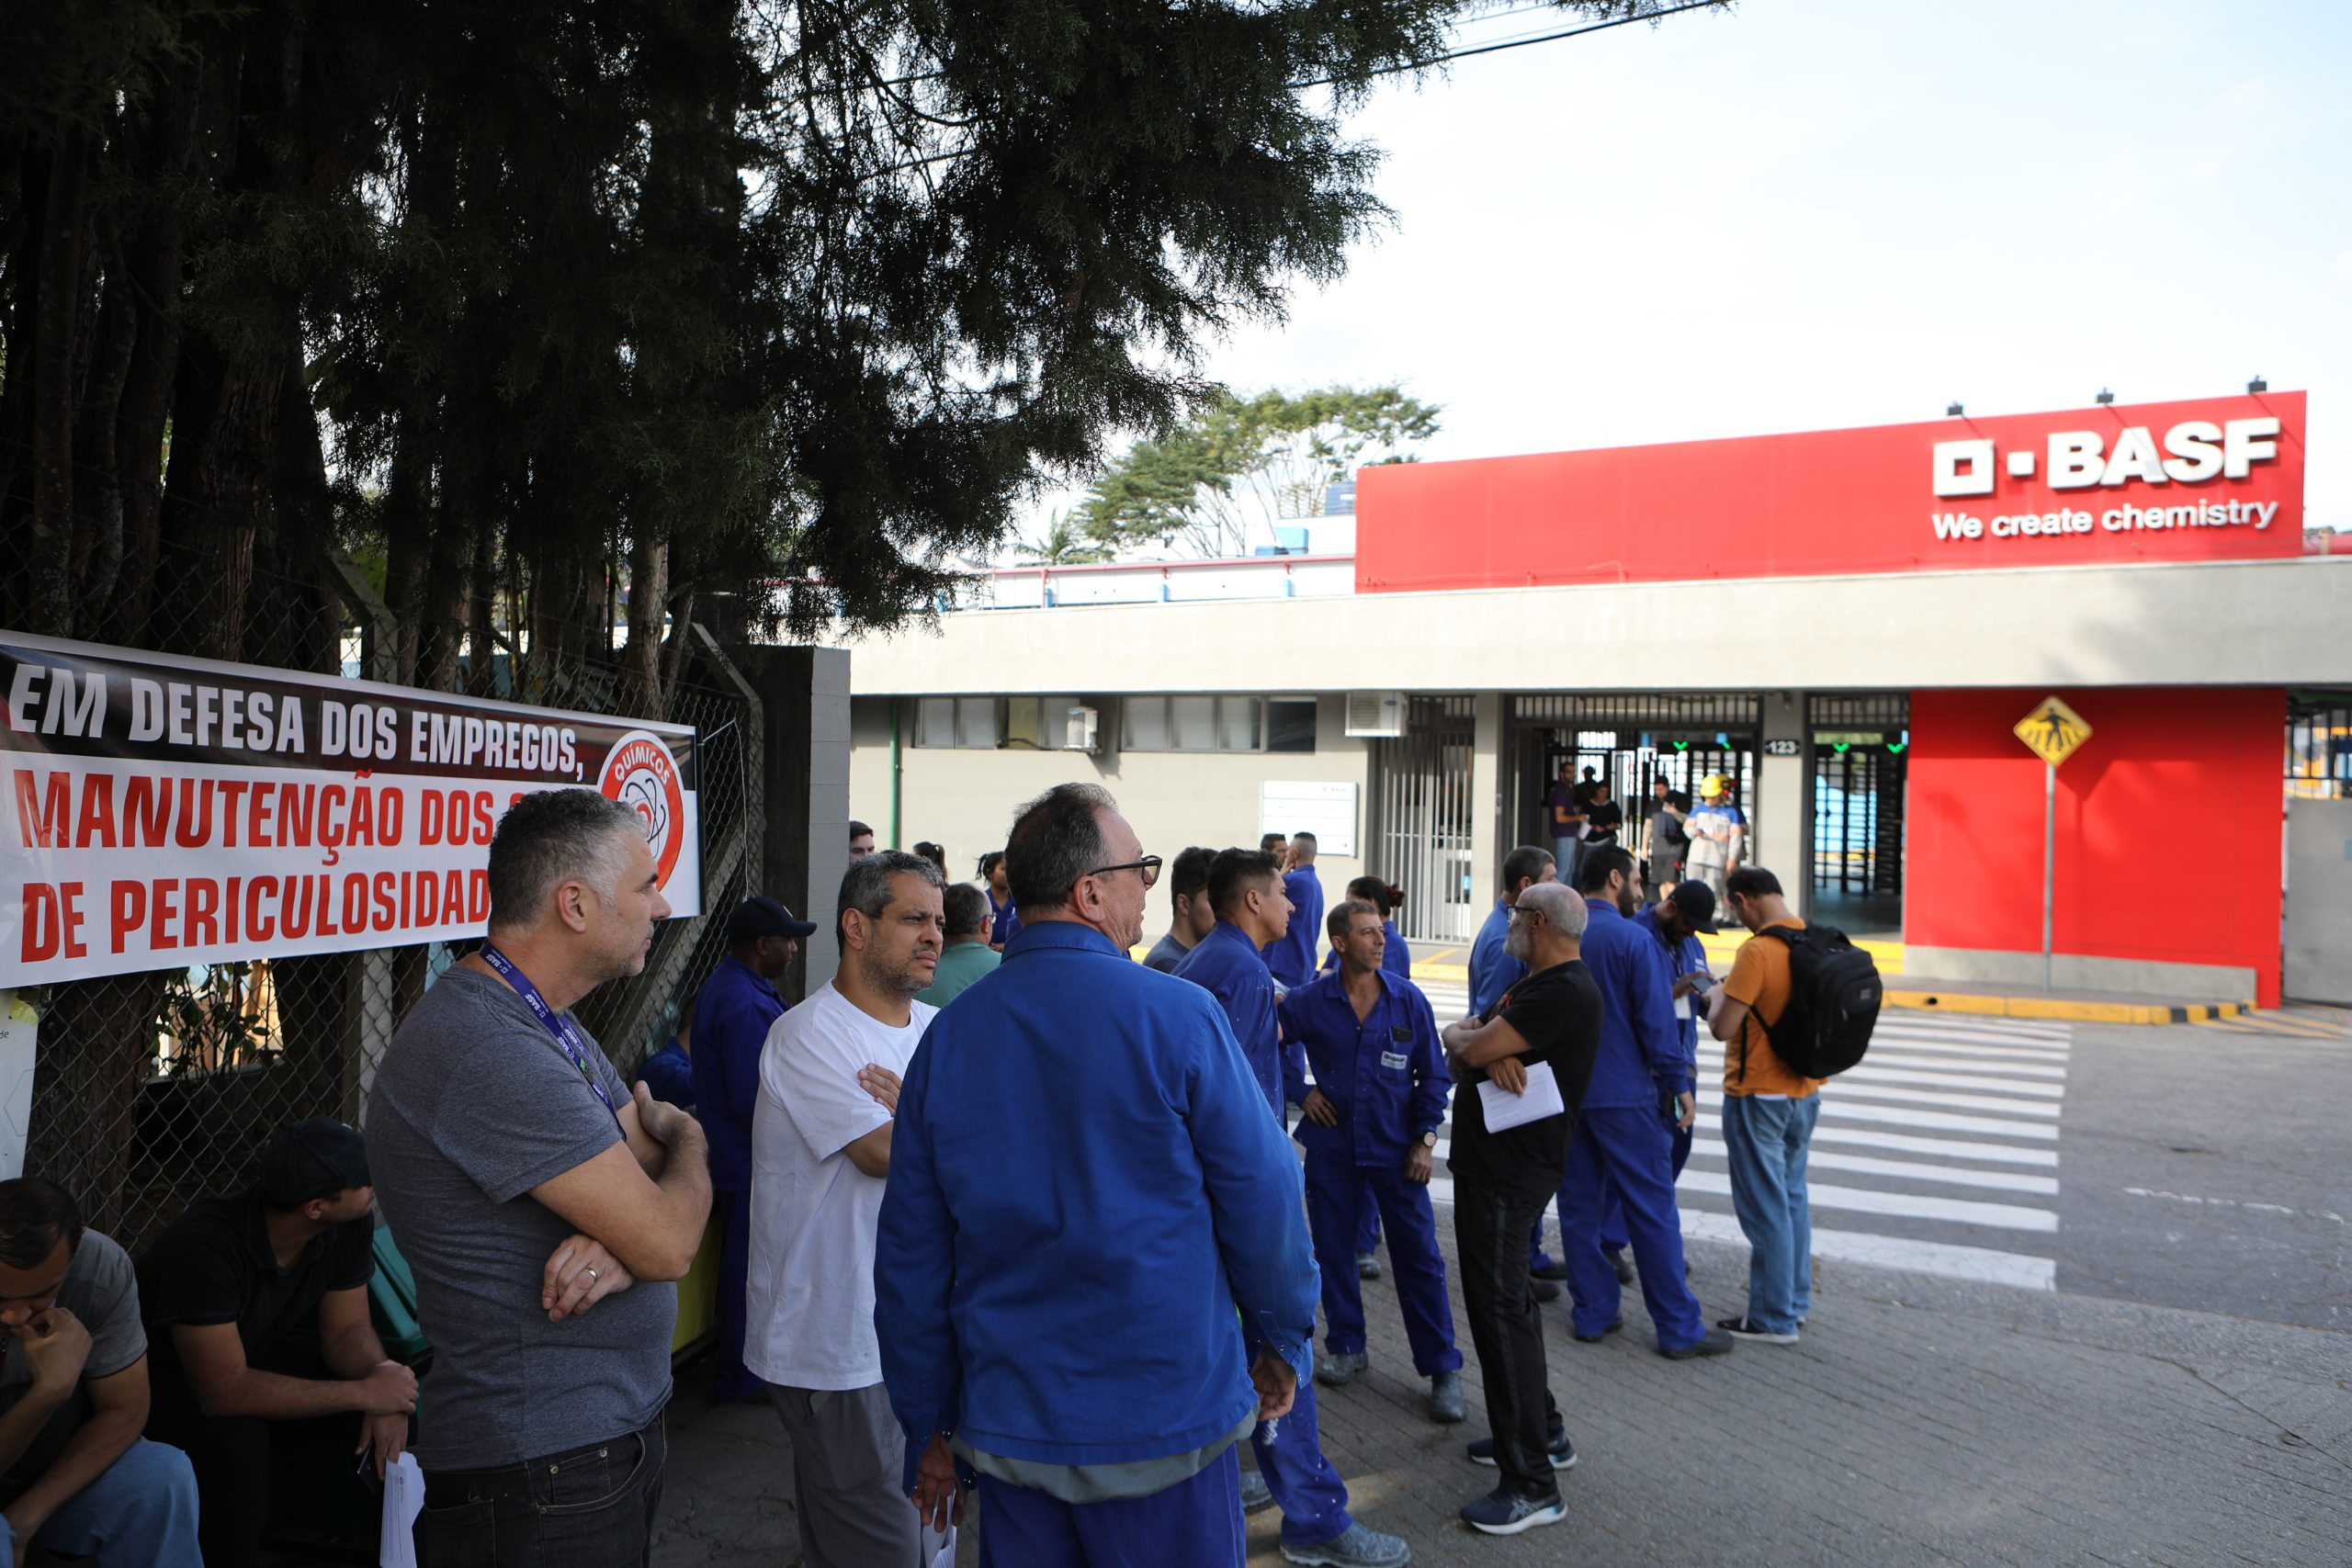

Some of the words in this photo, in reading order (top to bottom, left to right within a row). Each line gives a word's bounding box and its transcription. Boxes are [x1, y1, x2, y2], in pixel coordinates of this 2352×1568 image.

[2047, 417, 2280, 490] BASF
[1932, 513, 1983, 539] We
[1991, 507, 2093, 537] create
[2101, 498, 2278, 531] chemistry
[9, 663, 107, 739] EM
[129, 677, 305, 754] DEFESA
[322, 700, 397, 761] DOS
[411, 711, 583, 782] EMPREGOS,
[1770, 740, 1796, 754] 123
[615, 742, 670, 785] QUÍMICOS
[14, 769, 403, 866] MANUTENÇÃO
[420, 789, 493, 845] DOS
[21, 882, 87, 963] DE
[525, 993, 541, 1010] BASF
